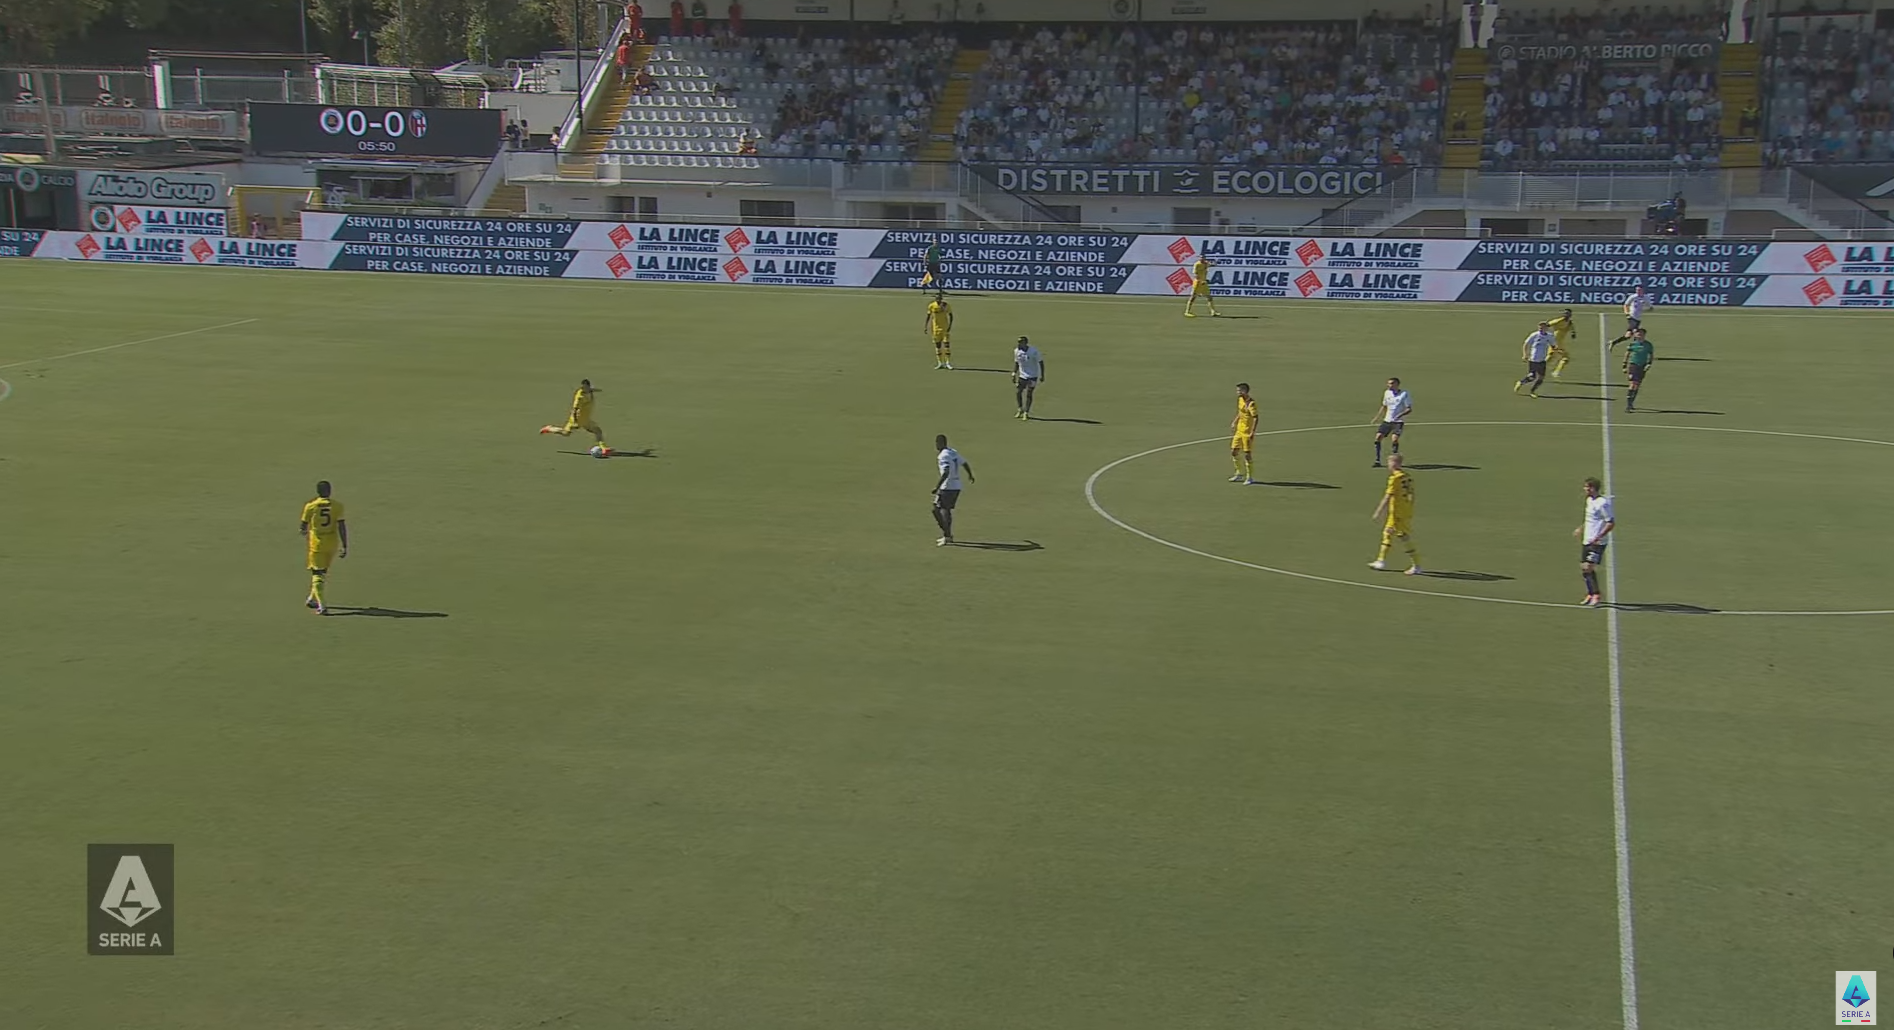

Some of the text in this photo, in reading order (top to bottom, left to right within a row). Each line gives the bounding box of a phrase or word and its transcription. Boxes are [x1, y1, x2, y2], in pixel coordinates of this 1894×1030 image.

[347, 110, 405, 137] 0-0
[358, 141, 396, 151] 05:50
[89, 174, 215, 203] Alioto Group
[998, 168, 1382, 194] DISTRETTI ECOLOGICI
[146, 210, 224, 226] LA LINCE
[347, 217, 572, 234] SERVIZI DI SICUREZZA 24 ORE SU 24
[1, 231, 40, 243] SU 24
[369, 233, 552, 248] PER CASE, NEGOZI E AZIENDE
[639, 227, 720, 243] LA LINCE
[755, 231, 838, 246] LA LINCE
[941, 234, 953, 244] DI
[959, 234, 1031, 245] SICUREZZA
[1036, 235, 1053, 246] 24
[1058, 236, 1084, 246] ORE
[1089, 237, 1106, 247] SU
[1111, 237, 1128, 247] 24
[105, 236, 184, 253] LA LINCE
[218, 240, 297, 257] LA LINCE
[1201, 240, 1291, 256] LA LINCE
[1330, 242, 1423, 258] LA LINCE
[1478, 242, 1758, 256] SERVIZI DI SICUREZZA 24 ORE SU 24
[345, 245, 570, 262] SERVIZI DI SICUREZZA 24 ORE SU 24
[909, 248, 929, 258] PE
[978, 250, 1031, 261] NEGOZI
[1036, 251, 1042, 262] E
[1048, 251, 1105, 262] AZIENDE
[1844, 246, 1874, 262] LA
[367, 260, 549, 276] PER CASE, NEGOZI E AZIENDE
[637, 255, 718, 271] LA LINCE
[753, 260, 836, 275] LA LINCE
[885, 261, 1127, 277] SERVI DI SICUREZZA 24 ORE SU 24
[1502, 260, 1730, 272] PER CASE, NEGOZI E AZIENDE
[977, 279, 1030, 291] NEGOZI
[1035, 281, 1041, 291] E
[1046, 281, 1104, 292] AZIENDE
[1232, 271, 1289, 287] LINCE
[1328, 273, 1422, 289] LA LINCE
[1476, 274, 1756, 288] SERVIZI DI SICUREZZA 24 ORE SU 24
[1842, 280, 1874, 295] LA
[1502, 291, 1728, 304] PER CASE, NEGO E AZIENDE
[320, 508, 331, 526] 5
